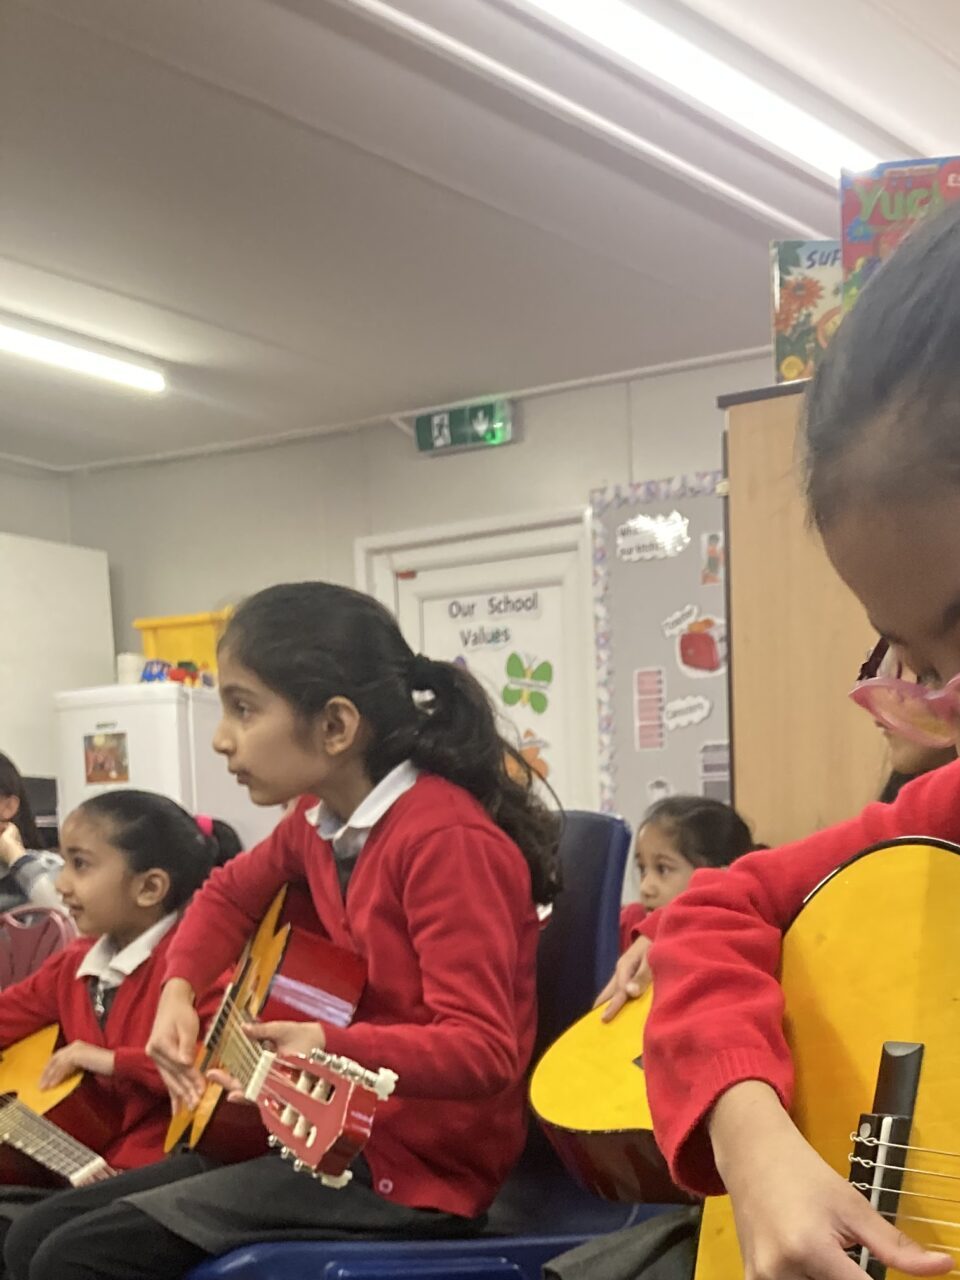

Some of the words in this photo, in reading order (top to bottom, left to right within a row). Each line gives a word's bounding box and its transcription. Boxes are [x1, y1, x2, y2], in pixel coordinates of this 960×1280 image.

[448, 600, 476, 619] Our
[487, 591, 539, 615] School
[459, 625, 511, 648] Values
